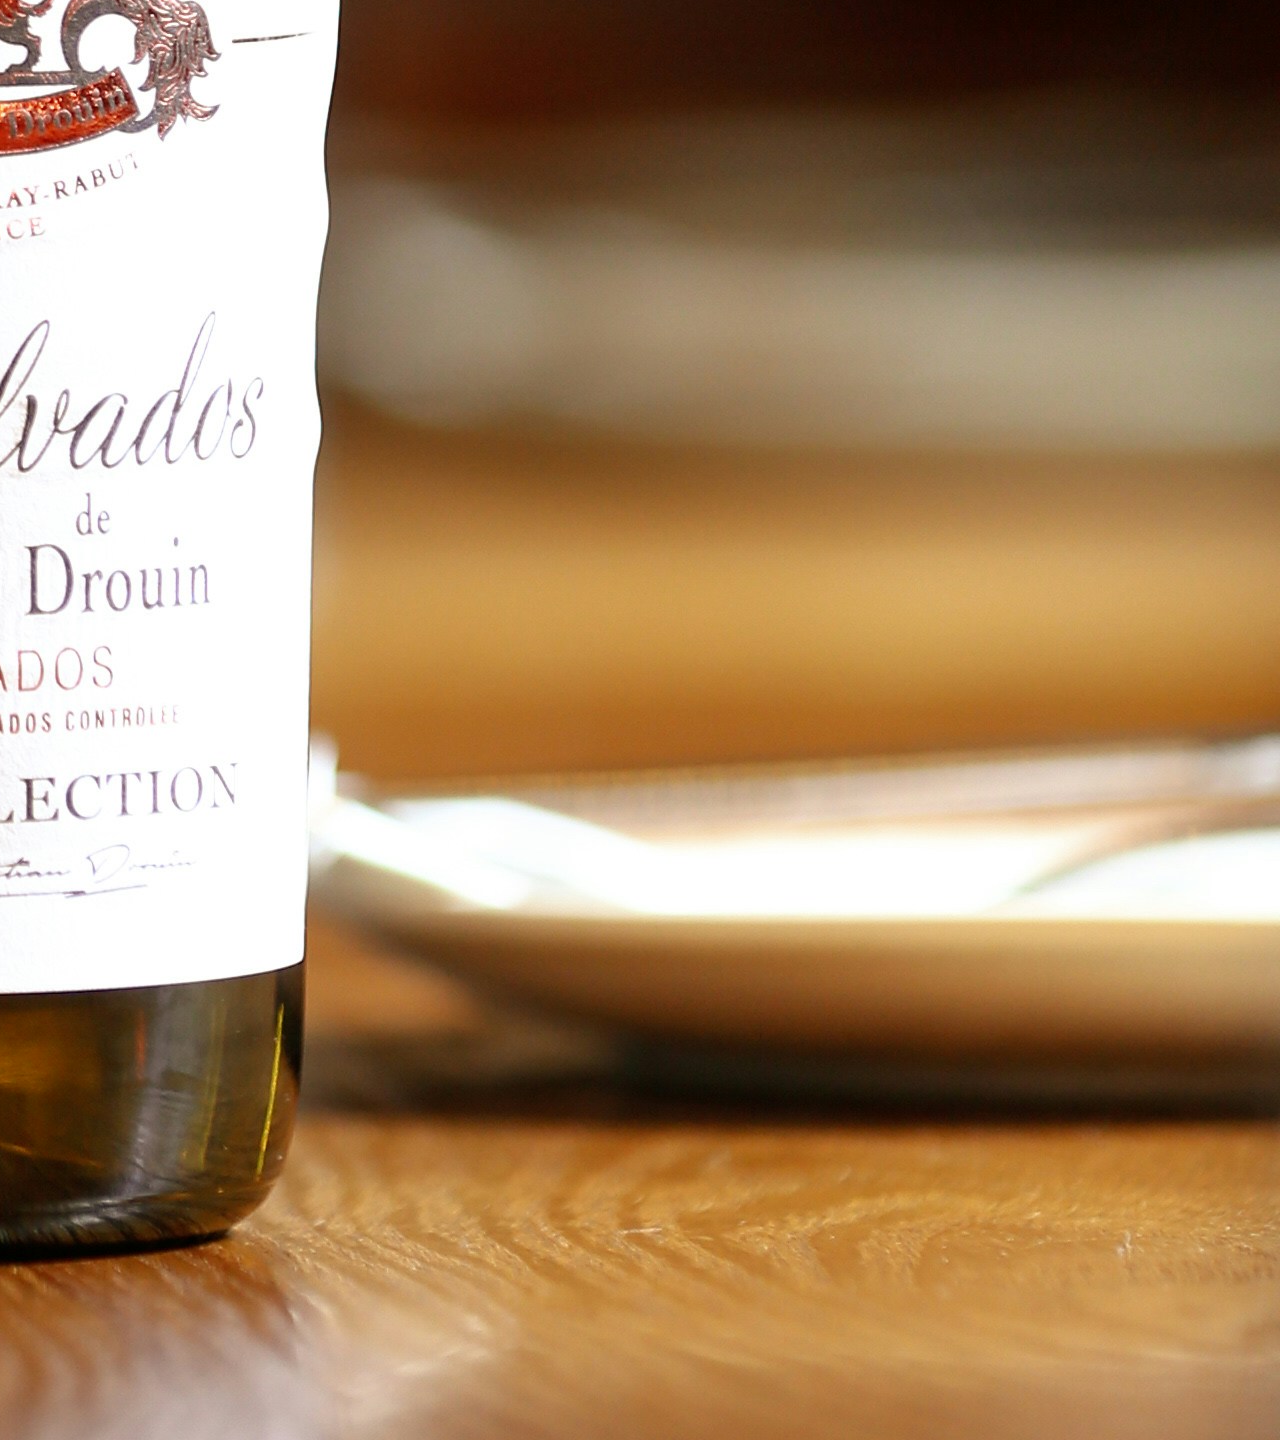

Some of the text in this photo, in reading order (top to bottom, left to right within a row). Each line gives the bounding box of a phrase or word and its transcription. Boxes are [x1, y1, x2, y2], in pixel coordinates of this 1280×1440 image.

[4, 80, 130, 140] Drouin
[74, 492, 112, 537] de
[24, 537, 212, 618] Drouin
